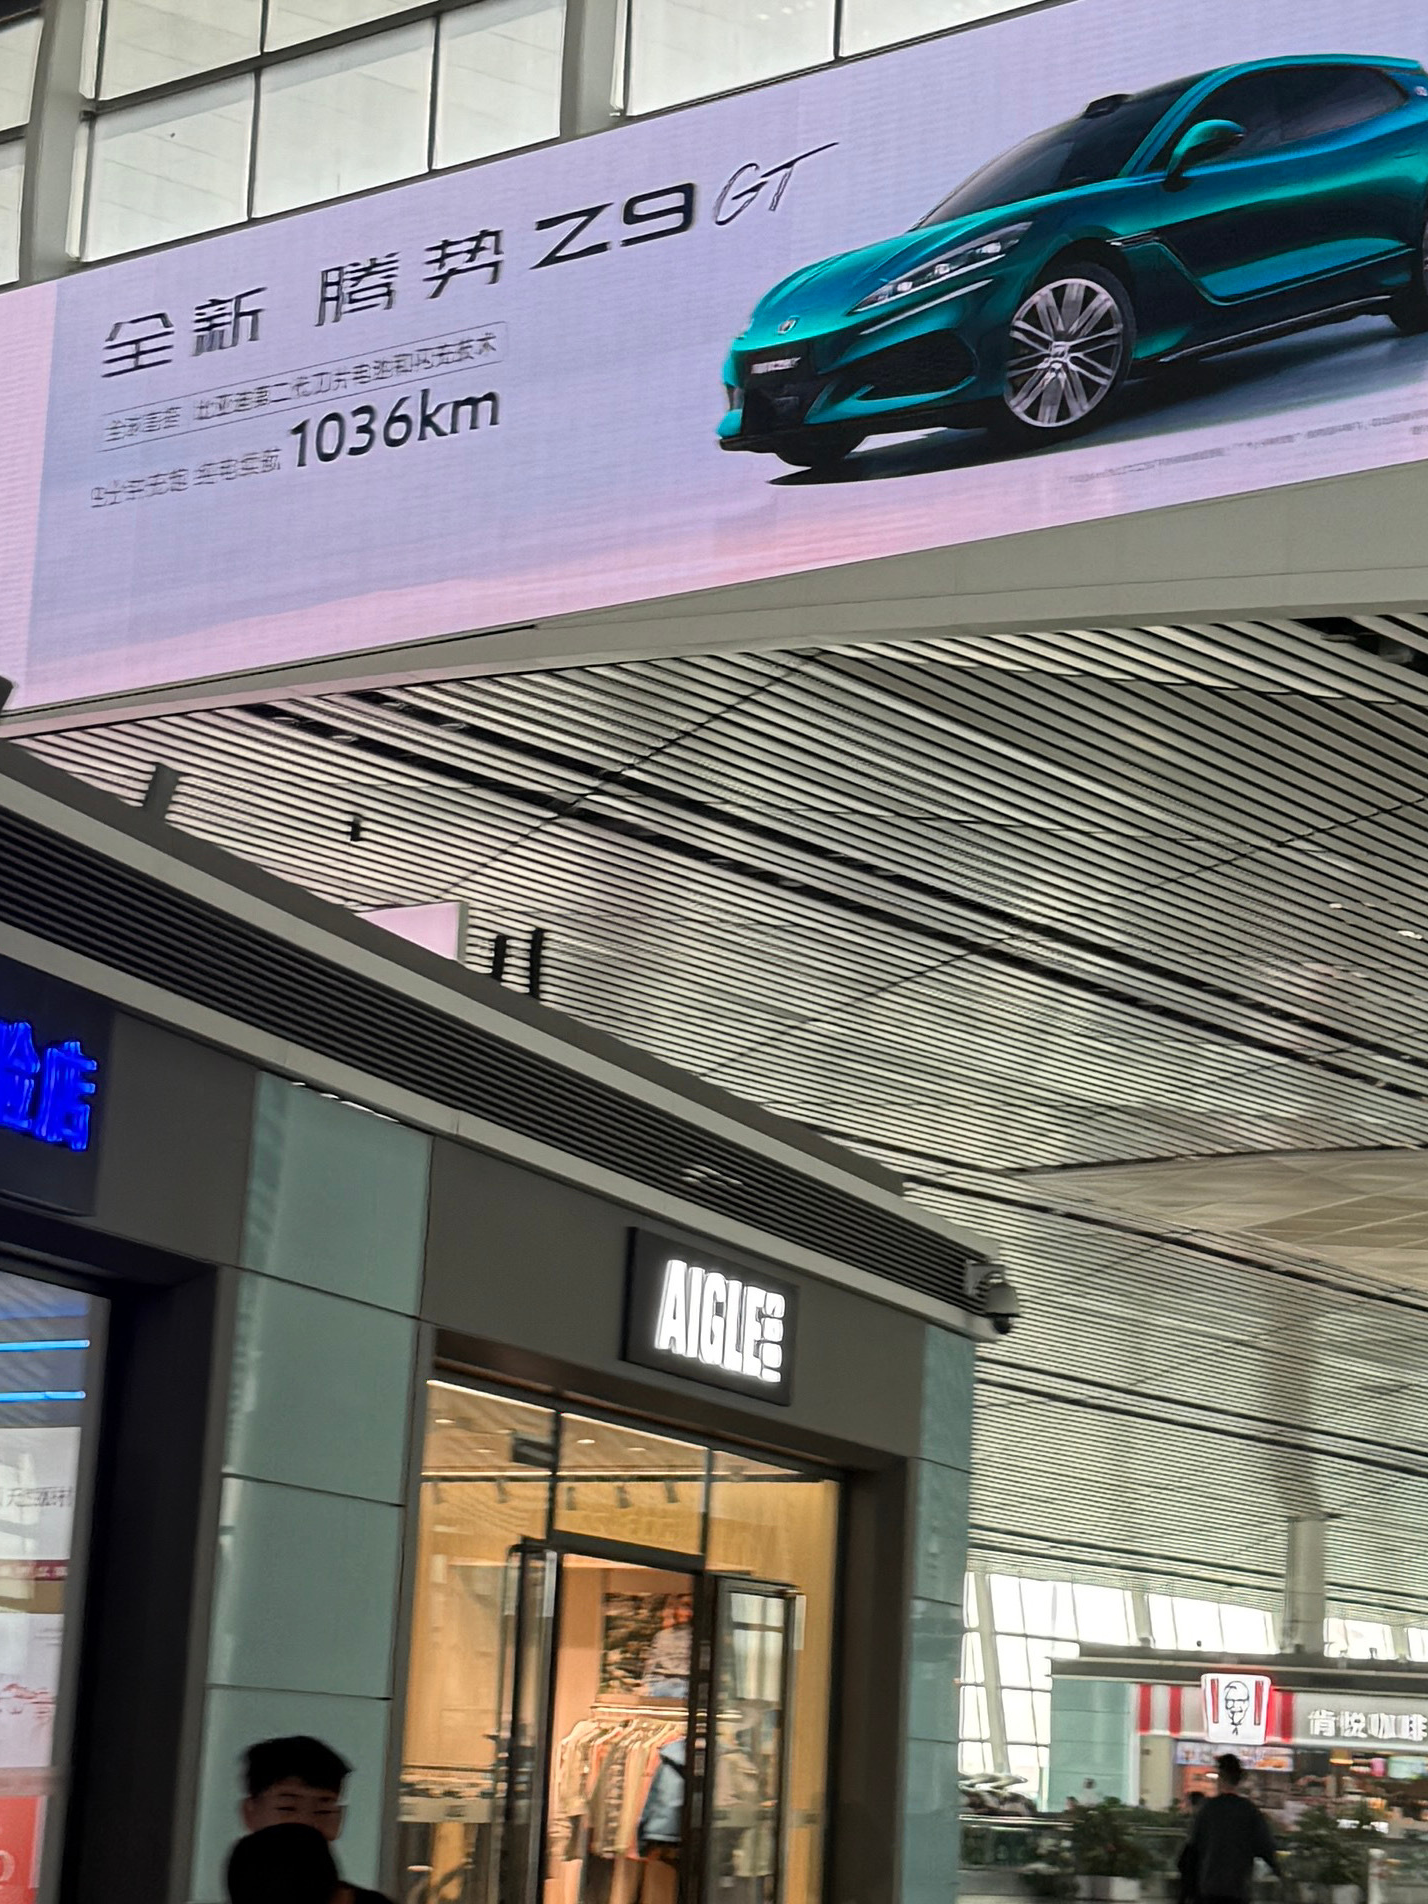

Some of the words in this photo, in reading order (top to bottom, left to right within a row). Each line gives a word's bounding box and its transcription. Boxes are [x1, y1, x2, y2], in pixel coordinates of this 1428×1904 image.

[102, 287, 268, 380] 全新
[314, 228, 506, 328] 腾势
[289, 387, 501, 468] 1036km
[654, 1259, 768, 1378] AIGLE
